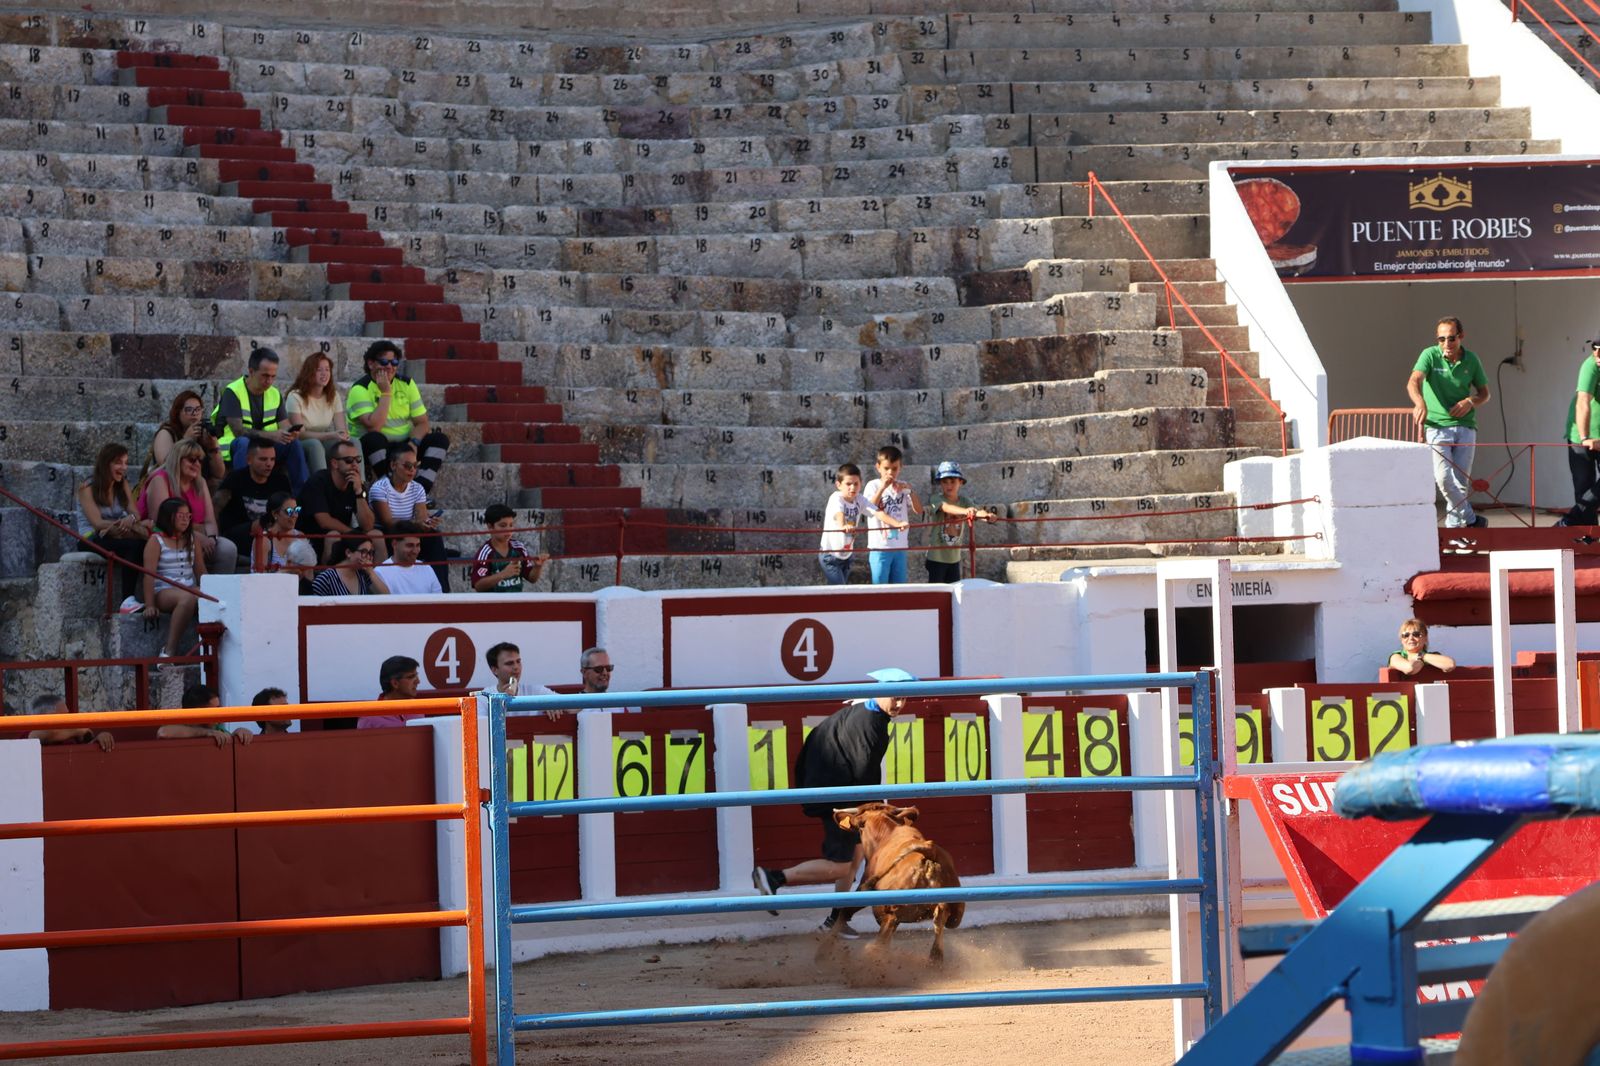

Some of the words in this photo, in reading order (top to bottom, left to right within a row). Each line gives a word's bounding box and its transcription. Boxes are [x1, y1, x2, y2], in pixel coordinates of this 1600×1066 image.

[1067, 15, 1074, 26] 3
[1112, 15, 1120, 27] 4
[1164, 14, 1171, 24] 5
[1255, 13, 1261, 23] 7
[1308, 14, 1314, 25] 8
[1358, 13, 1364, 24] 9
[135, 20, 146, 34] 17
[192, 24, 205, 38] 18
[919, 21, 937, 36] 32
[253, 33, 264, 45] 19
[296, 32, 310, 44] 20
[351, 32, 362, 45] 21
[415, 37, 429, 50] 22
[830, 31, 844, 44] 30
[468, 41, 481, 53] 23
[519, 44, 534, 55] 24
[575, 47, 589, 60] 25
[736, 42, 751, 54] 28
[29, 48, 40, 63] 18
[911, 52, 925, 65] 32
[1022, 50, 1029, 60] 2
[1075, 49, 1082, 62] 3
[1183, 48, 1190, 60] 5
[259, 65, 275, 76] 20
[867, 60, 881, 74] 31
[344, 69, 355, 80] 21
[402, 70, 416, 84] 22
[812, 69, 829, 82] 30
[456, 75, 470, 88] 23
[510, 76, 523, 89] 24
[559, 78, 574, 91] 25
[613, 79, 628, 90] 26
[709, 76, 722, 89] 28
[1089, 83, 1097, 93] 2
[1198, 82, 1206, 93] 4
[1253, 81, 1259, 93] 5
[10, 86, 21, 100] 16
[977, 85, 993, 98] 32
[118, 92, 130, 107] 18
[873, 98, 889, 111] 30
[327, 100, 345, 113] 20
[658, 110, 675, 127] 26
[996, 118, 1010, 130] 26
[1109, 114, 1116, 125] 2
[1160, 113, 1168, 125] 3
[1216, 113, 1225, 126] 4
[1273, 112, 1281, 124] 5
[1326, 113, 1333, 126] 6
[37, 122, 48, 136] 10
[154, 128, 166, 142] 12
[795, 139, 810, 154] 22
[1127, 146, 1135, 158] 2
[1290, 145, 1299, 159] 5
[1352, 143, 1360, 157] 6
[36, 154, 48, 167] 10
[993, 156, 1009, 169] 26
[888, 164, 905, 178] 24
[457, 173, 468, 186] 16
[671, 174, 686, 185] 20
[82, 193, 96, 205] 10
[917, 196, 932, 210] 23
[375, 206, 387, 222] 13
[431, 208, 443, 221] 14
[696, 206, 708, 221] 19
[749, 206, 766, 220] 20
[41, 222, 49, 238] 8
[158, 229, 173, 241] 10
[1352, 220, 1443, 243] PUENTE
[1452, 217, 1532, 240] ROBLES
[474, 242, 487, 257] 14
[524, 244, 536, 256] 15
[696, 239, 707, 253] 18
[750, 238, 761, 253] 19
[1396, 249, 1434, 258] JAMONES
[1442, 248, 1490, 257] EMBUTIDOS
[36, 256, 43, 269] 7
[96, 260, 104, 276] 8
[1374, 262, 1383, 271] El
[1383, 261, 1407, 273] mejor
[1408, 260, 1437, 270] chorizo
[1437, 260, 1464, 269] ibérico
[1464, 260, 1477, 269] del
[1048, 265, 1063, 278] 23
[1099, 265, 1113, 276] 24
[503, 275, 516, 289] 13
[915, 282, 929, 295] 20
[15, 297, 23, 309] 6
[82, 299, 90, 311] 7
[147, 301, 155, 317] 8
[267, 308, 279, 319] 10
[318, 304, 328, 321] 11
[484, 308, 496, 321] 12
[932, 313, 945, 324] 20
[1001, 307, 1013, 318] 21
[11, 337, 20, 351] 5
[76, 336, 85, 350] 6
[525, 345, 538, 358] 12
[580, 348, 591, 361] 13
[701, 350, 712, 364] 15
[815, 351, 825, 363] 17
[929, 347, 941, 361] 19
[756, 353, 766, 365] 16
[1145, 373, 1158, 385] 21
[1190, 374, 1204, 389] 22
[11, 378, 20, 394] 4
[137, 383, 145, 398] 6
[1088, 381, 1105, 394] 20
[626, 390, 637, 403] 12
[683, 393, 693, 406] 13
[1132, 415, 1148, 429] 20
[1191, 410, 1205, 423] 21
[722, 430, 734, 444] 13
[1017, 425, 1027, 439] 18
[1171, 454, 1185, 467] 20
[1002, 466, 1015, 479] 17
[1061, 461, 1072, 474] 18
[48, 467, 56, 482] 3
[481, 468, 494, 481] 10
[705, 469, 717, 484] 12
[1033, 502, 1049, 515] 150
[1091, 500, 1105, 511] 151
[1137, 499, 1153, 510] 152
[1194, 496, 1211, 509] 153
[528, 510, 545, 525] 143
[805, 510, 822, 523] 146
[581, 564, 599, 582] 142
[640, 561, 660, 578] 143
[701, 558, 722, 576] 144
[83, 571, 105, 585] 134
[793, 626, 818, 673] 4
[434, 636, 461, 685] 4
[1316, 703, 1351, 761] 3
[1371, 699, 1405, 758] 2
[948, 720, 981, 781] 10
[1025, 714, 1062, 776] 4
[1084, 715, 1119, 777] 8
[888, 722, 914, 784] 11
[670, 737, 702, 795] 7
[753, 729, 775, 791] 1
[537, 744, 568, 801] 12
[616, 739, 651, 797] 6
